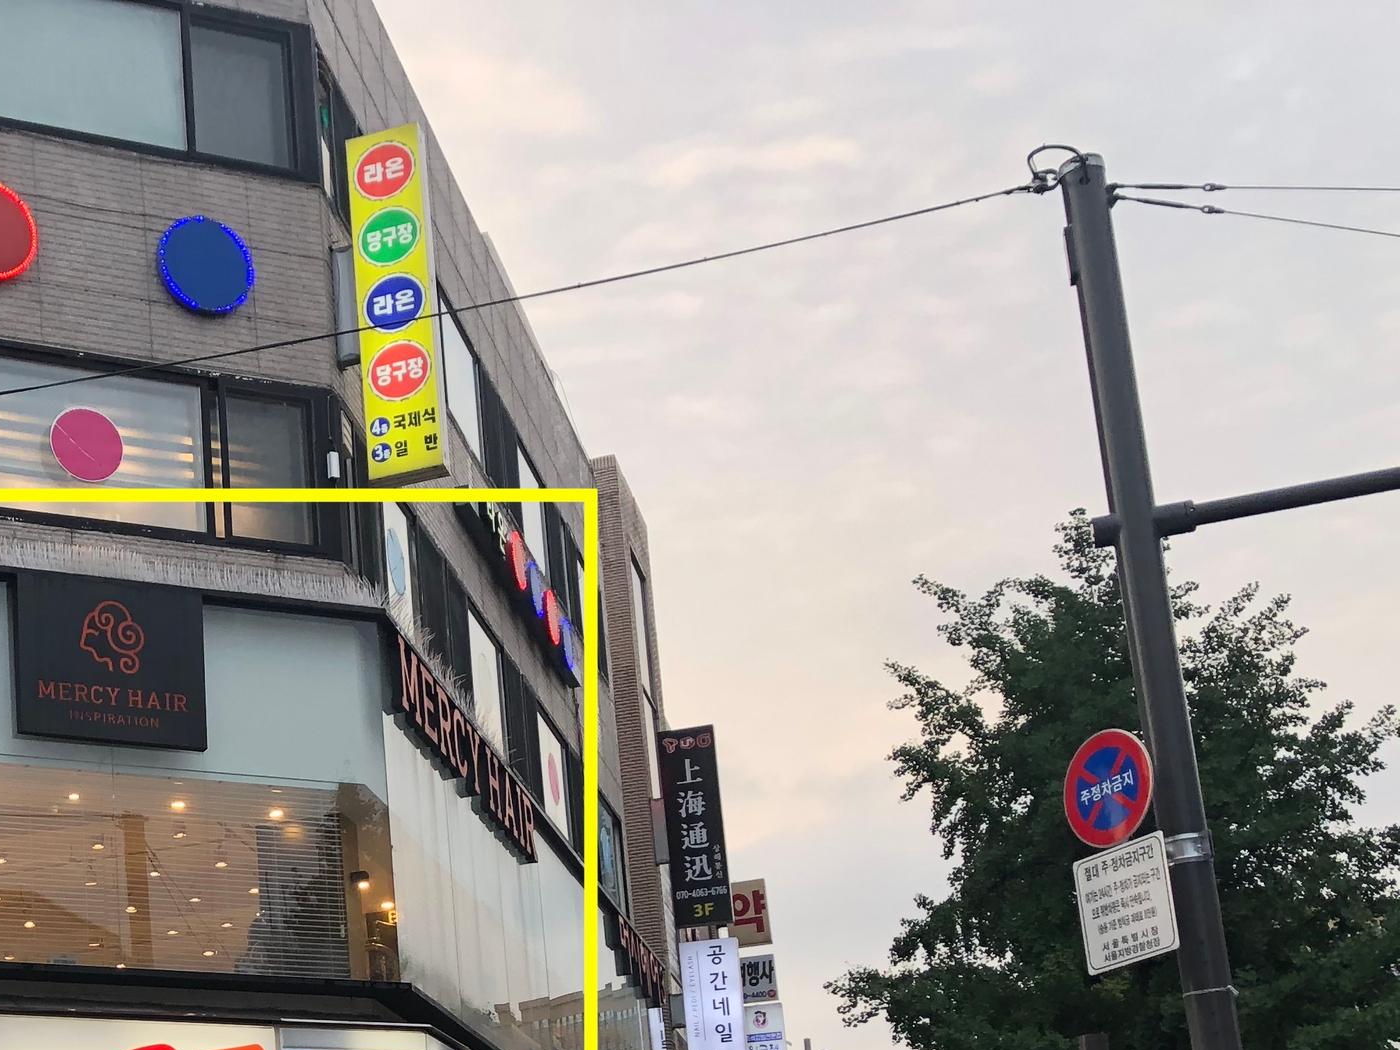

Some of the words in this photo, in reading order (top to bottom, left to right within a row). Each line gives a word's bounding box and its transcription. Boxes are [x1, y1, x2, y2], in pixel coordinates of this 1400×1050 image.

[363, 157, 404, 184] 라온
[366, 216, 413, 249] 당구장
[372, 288, 416, 316] 라온
[376, 357, 424, 388] 당구장
[393, 407, 437, 430] 국제식
[37, 679, 120, 706] MERCY
[128, 689, 189, 712] HAIR
[69, 709, 160, 728] INSPIRATION
[398, 634, 481, 796] MERCY
[485, 742, 536, 855] HAIR
[1080, 769, 1134, 806] 주정차금지
[694, 903, 714, 917] 3F
[707, 945, 733, 1043] 공간네일
